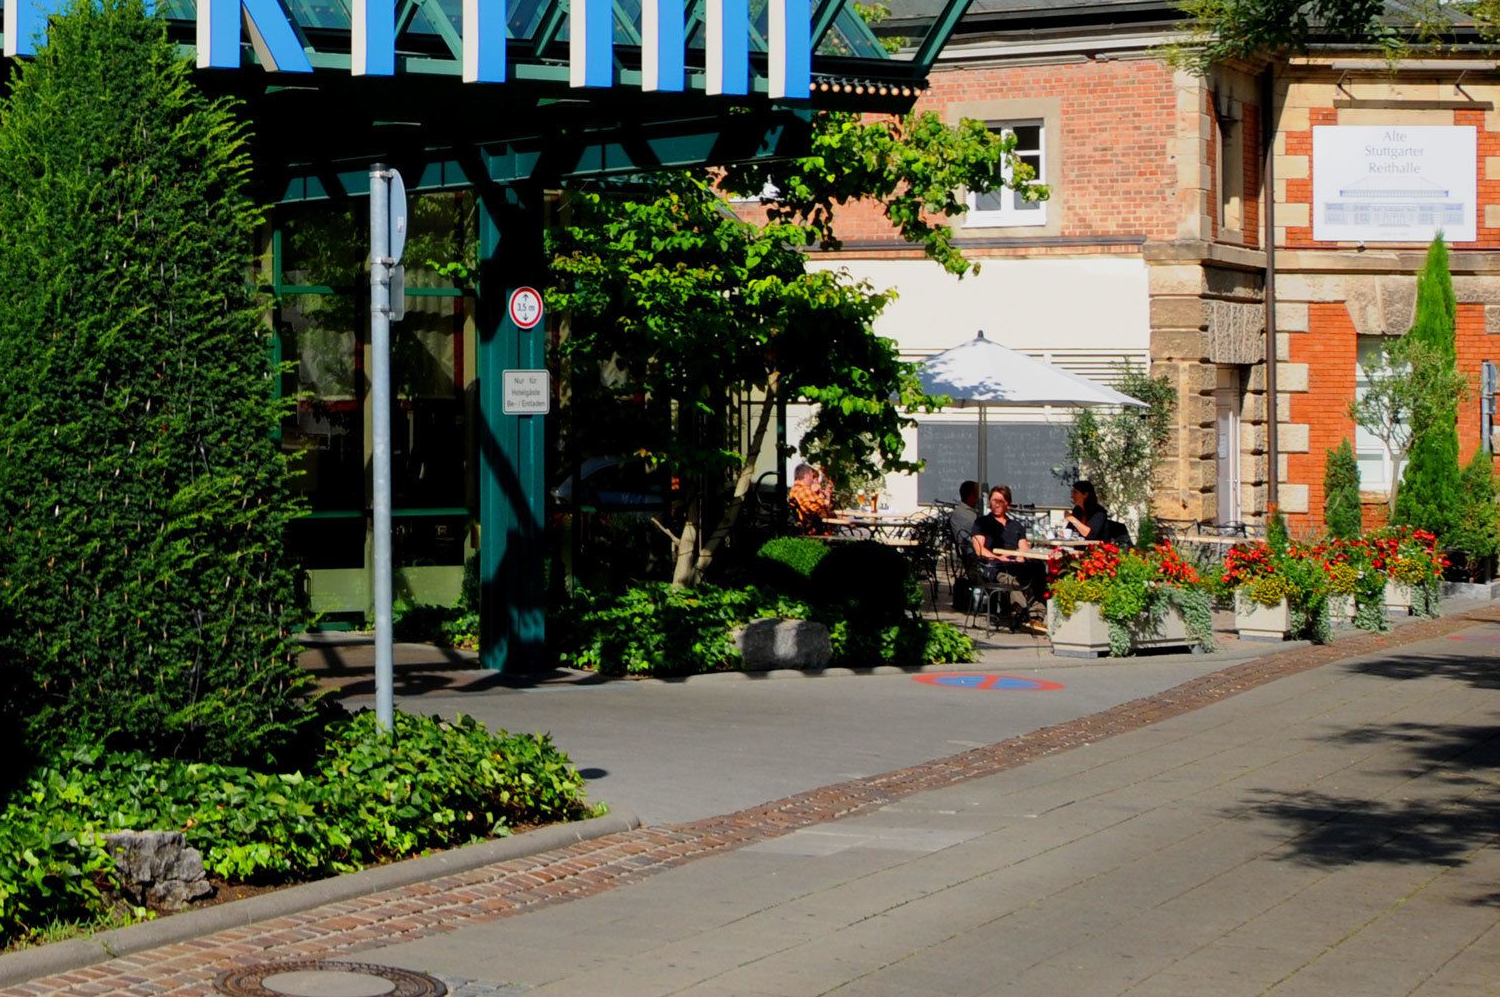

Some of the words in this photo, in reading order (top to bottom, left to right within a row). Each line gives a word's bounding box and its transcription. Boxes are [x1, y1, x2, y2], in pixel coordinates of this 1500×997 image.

[1382, 130, 1407, 142] Alte
[1364, 145, 1424, 159] Stuttgarter
[1368, 162, 1421, 174] Reithalle
[511, 388, 540, 397] Hotelgäste
[522, 399, 545, 407] Entladen
